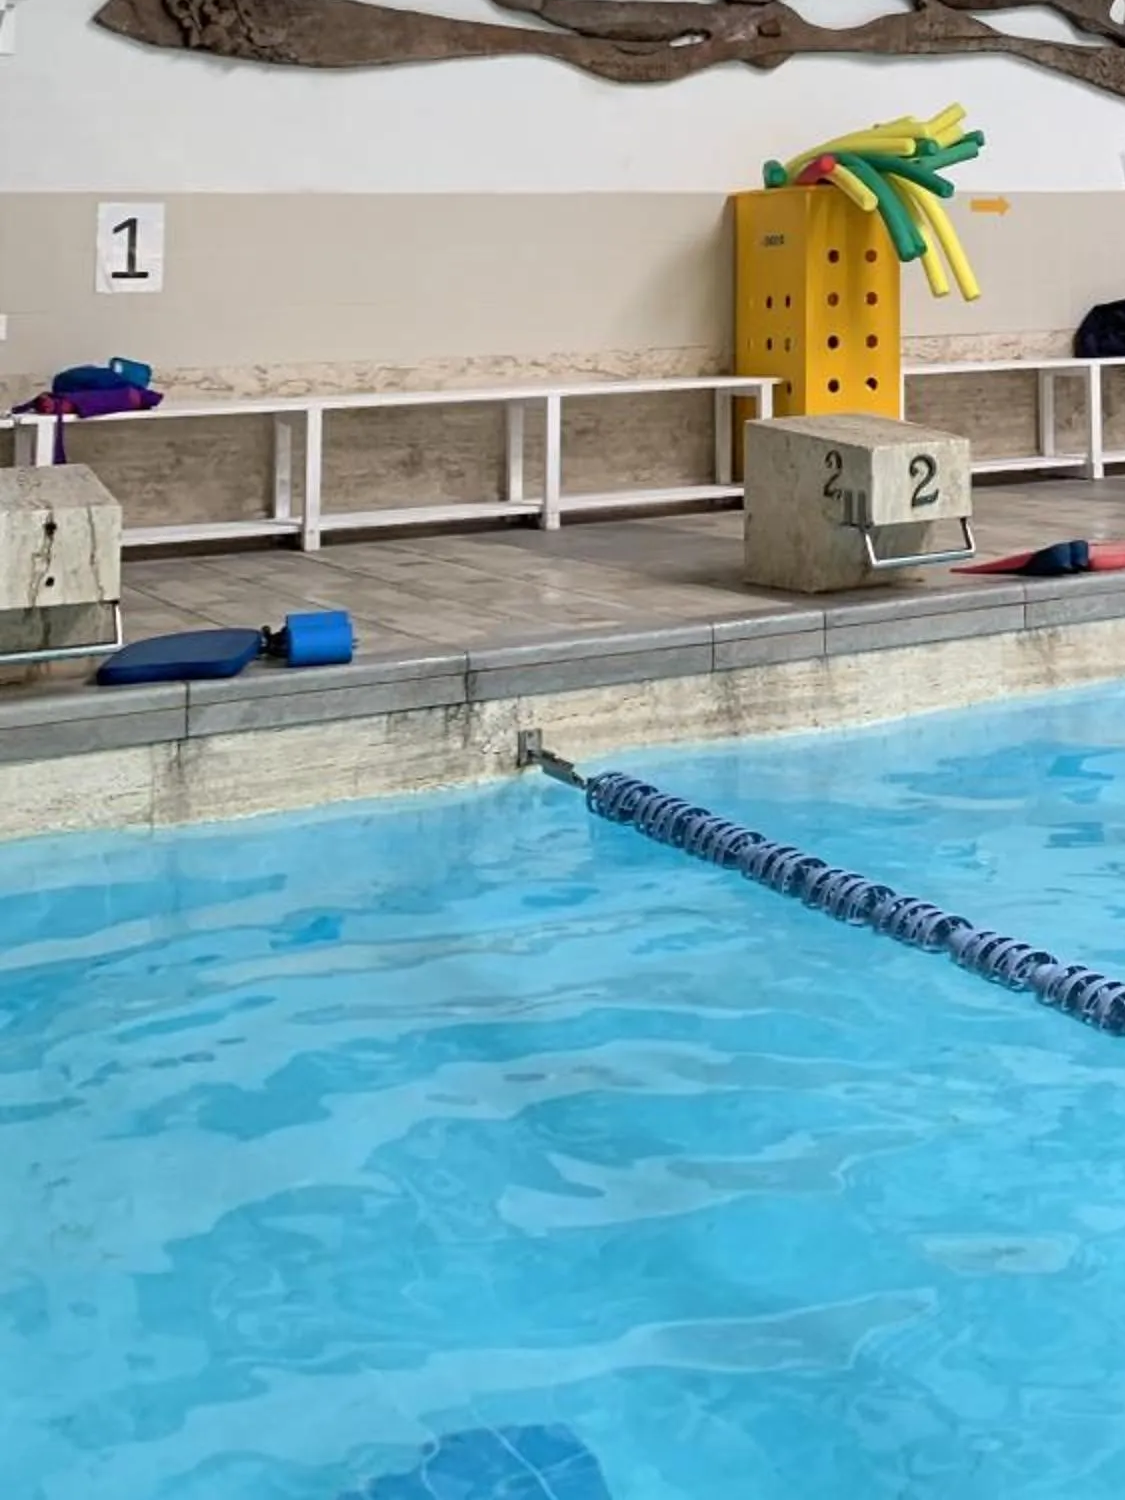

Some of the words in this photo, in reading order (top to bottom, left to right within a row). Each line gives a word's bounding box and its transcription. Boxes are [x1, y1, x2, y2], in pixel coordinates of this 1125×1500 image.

[112, 217, 149, 279] 1
[823, 449, 843, 500] 2
[909, 453, 940, 507] 2
